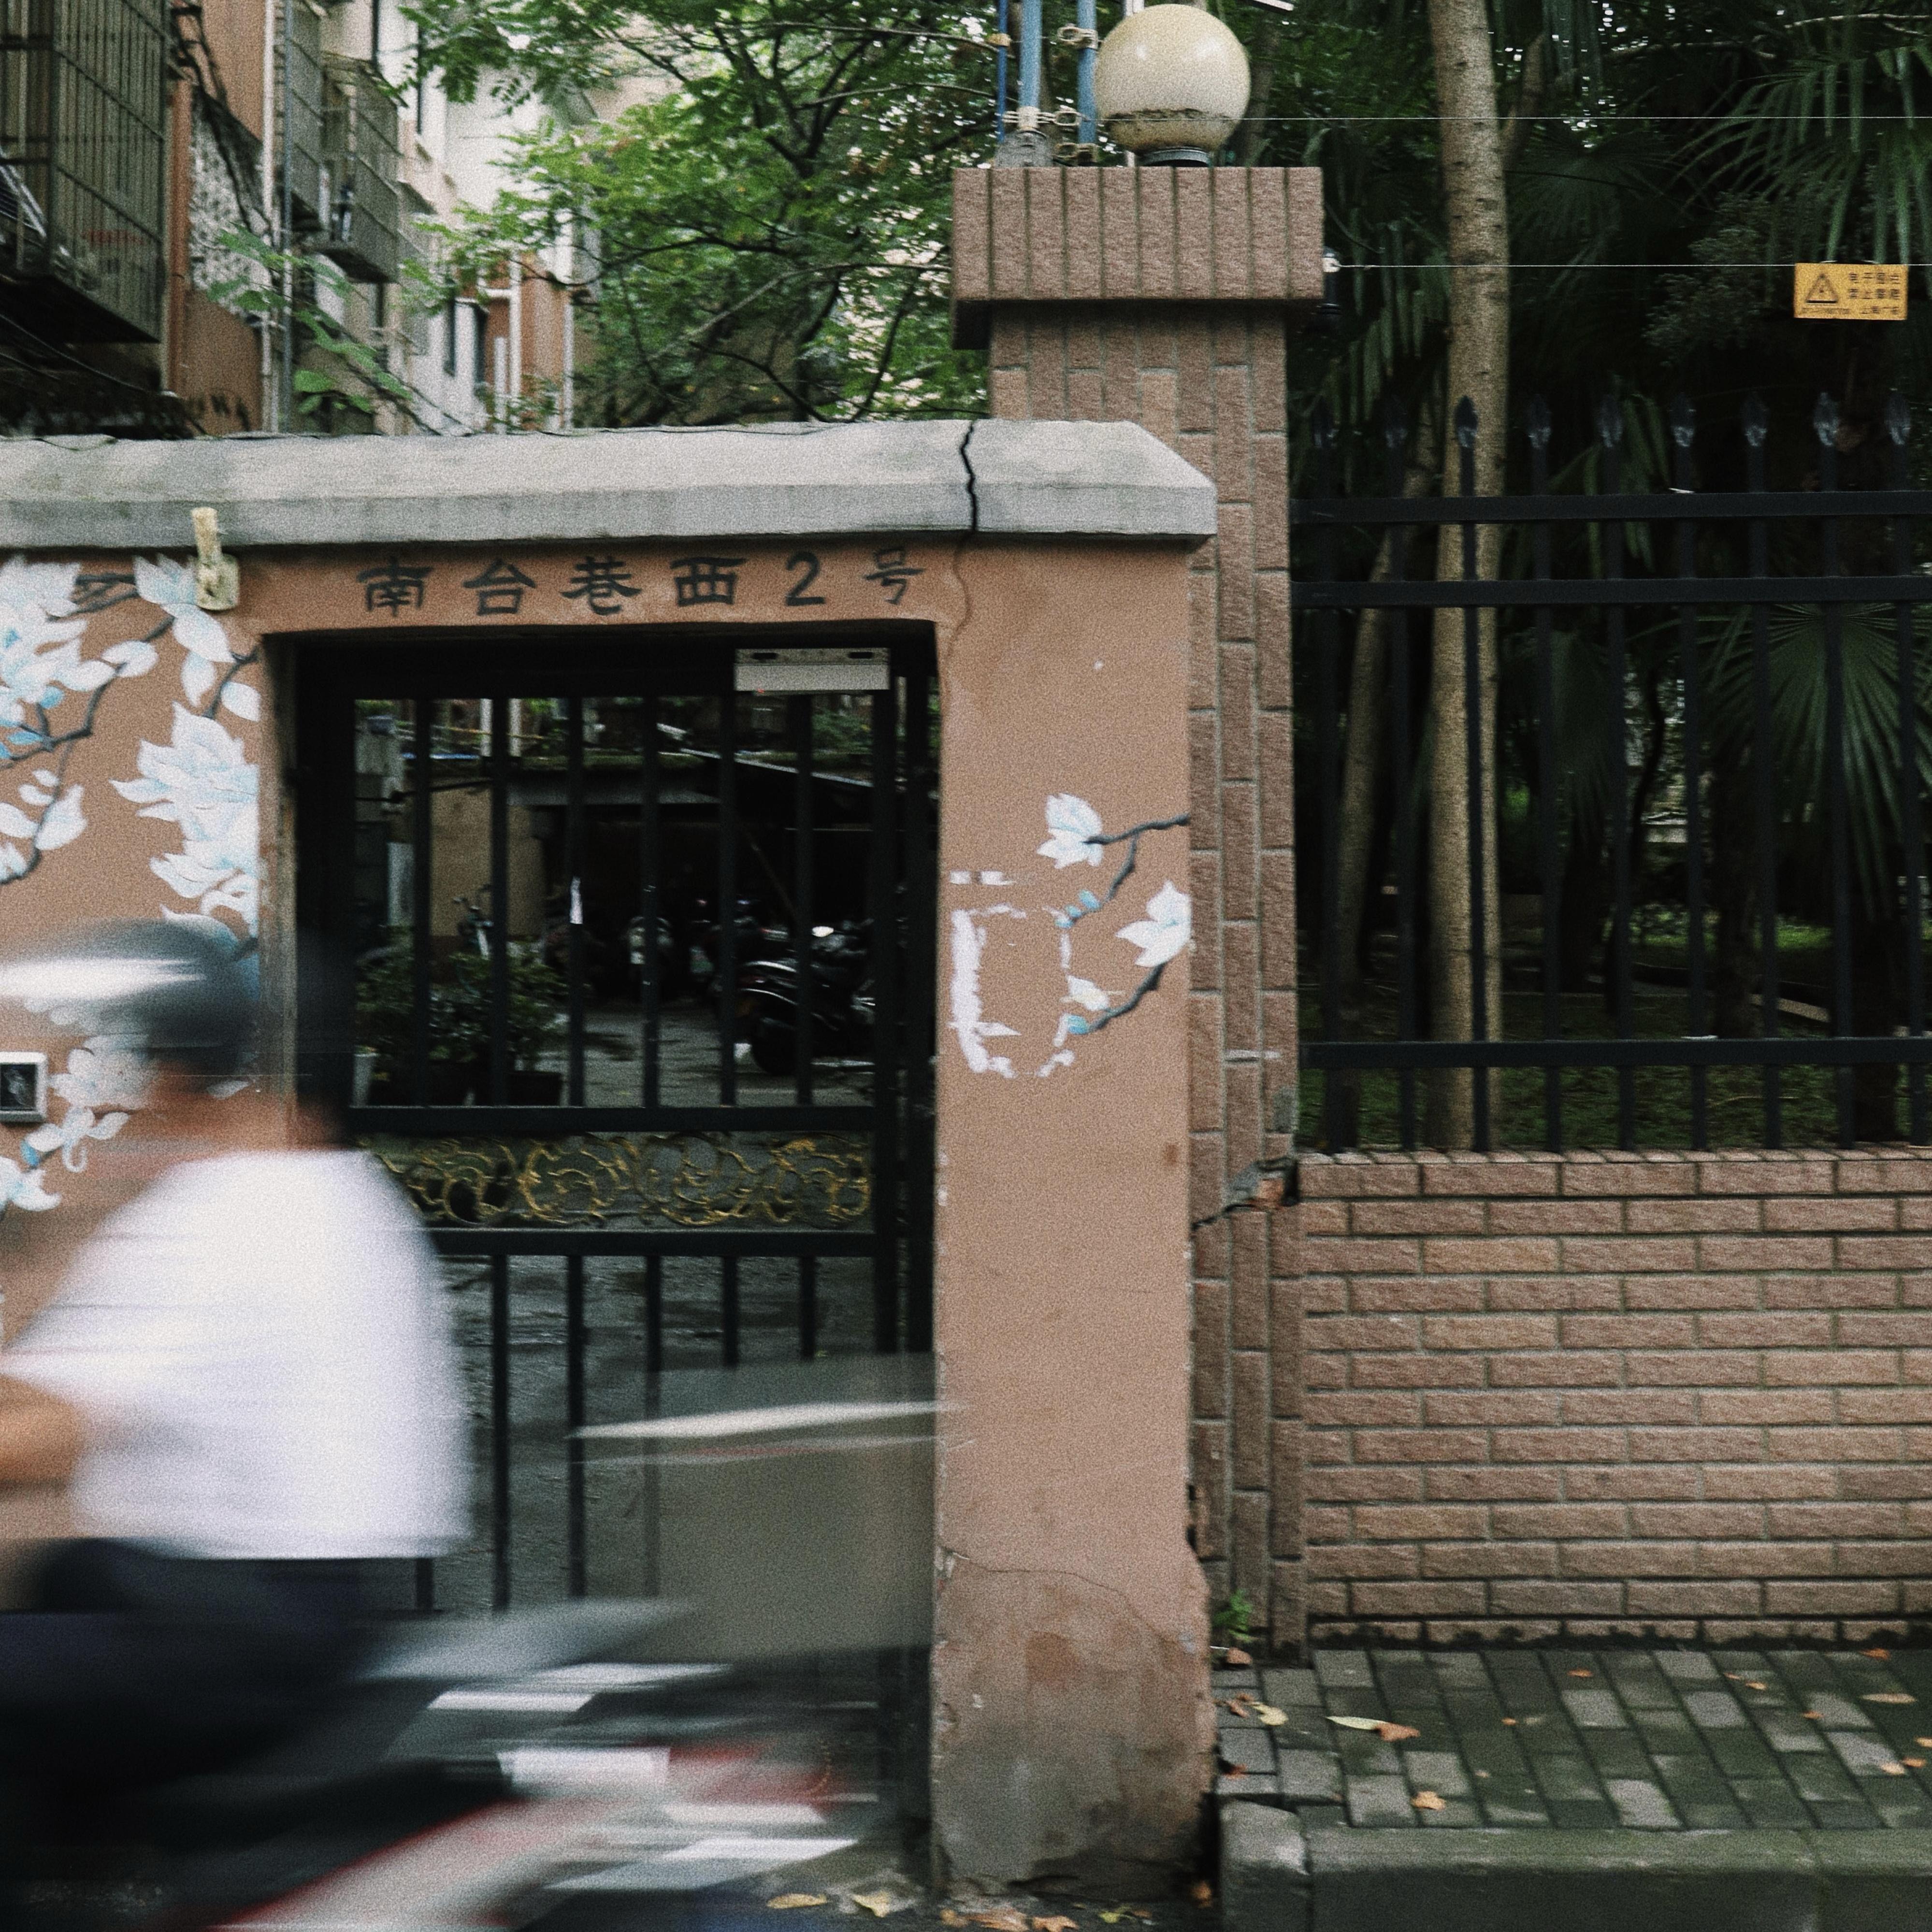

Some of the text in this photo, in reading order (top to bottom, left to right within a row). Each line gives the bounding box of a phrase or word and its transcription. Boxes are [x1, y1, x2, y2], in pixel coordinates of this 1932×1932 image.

[357, 547, 925, 617] 南台巷西2号
